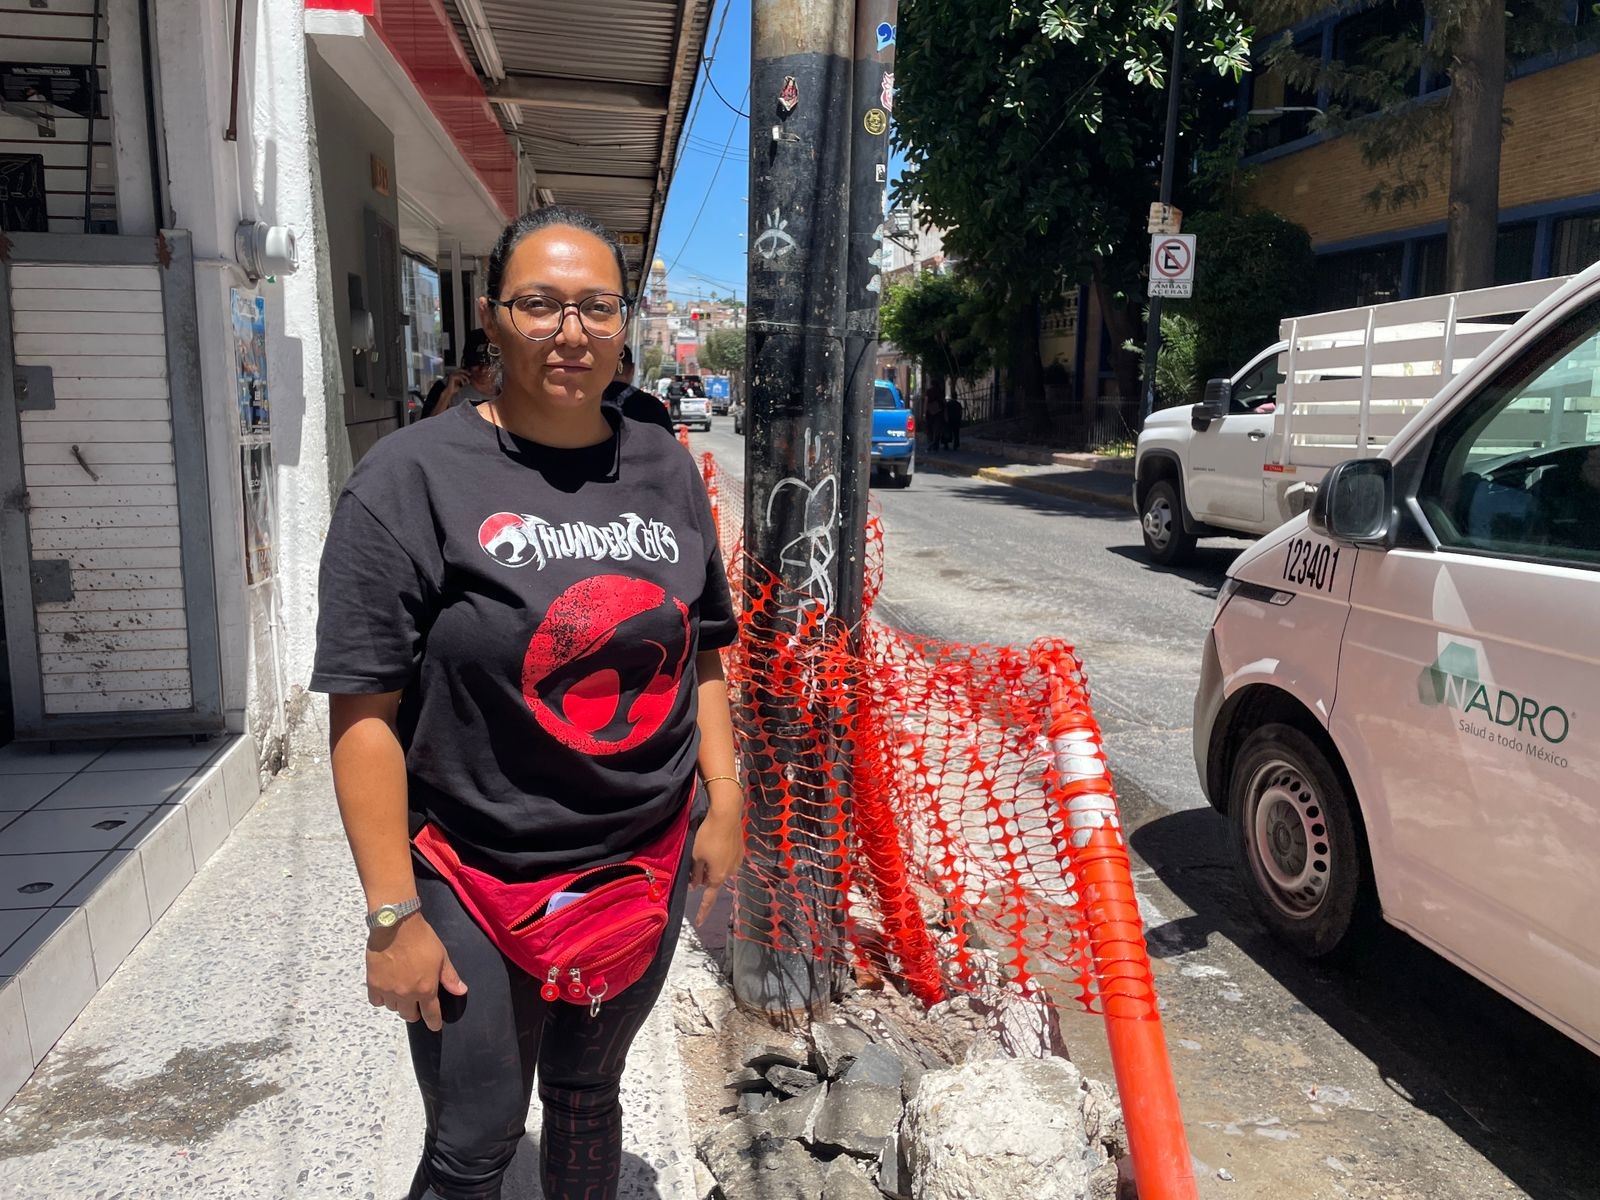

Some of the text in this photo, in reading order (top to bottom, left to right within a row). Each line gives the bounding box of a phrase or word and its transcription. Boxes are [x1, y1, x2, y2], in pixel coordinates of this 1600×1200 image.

[1283, 538, 1340, 592] 123401
[1444, 673, 1569, 744] NADRO
[1458, 719, 1568, 768] Salud a todo México
